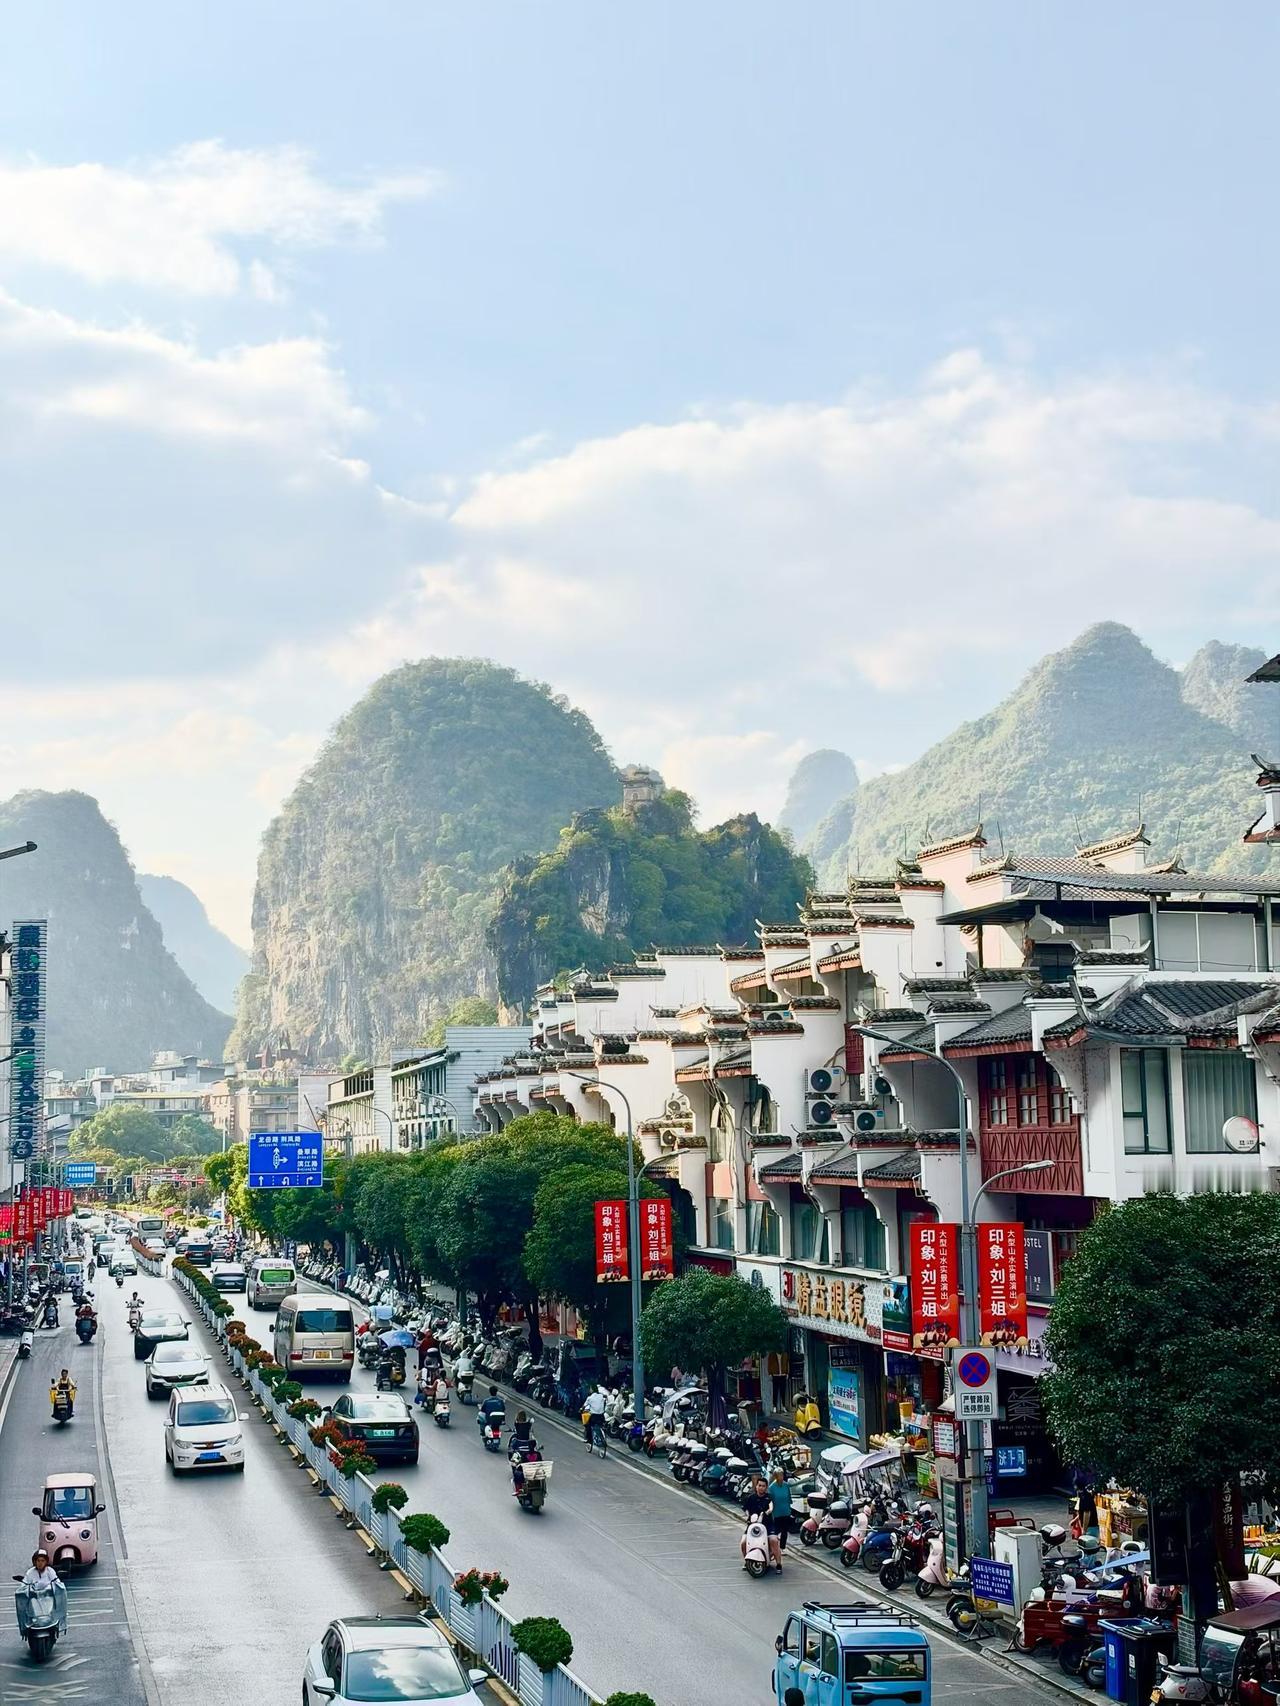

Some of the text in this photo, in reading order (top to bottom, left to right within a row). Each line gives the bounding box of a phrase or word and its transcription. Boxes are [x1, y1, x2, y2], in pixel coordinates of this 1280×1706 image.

[602, 1206, 614, 1264] 印象·刘三姐
[647, 1204, 660, 1261] 印象·刘三姐
[920, 1229, 938, 1317] 印象·刘三姐
[939, 1230, 949, 1300] 大型山水实景演出
[989, 1229, 1007, 1316] 印象·刘三姐
[1007, 1230, 1017, 1300] 大型山水实景演出
[797, 1272, 868, 1330] 精益眼镜
[963, 1395, 990, 1404] 严管路段
[963, 1404, 991, 1413] 违停即拍
